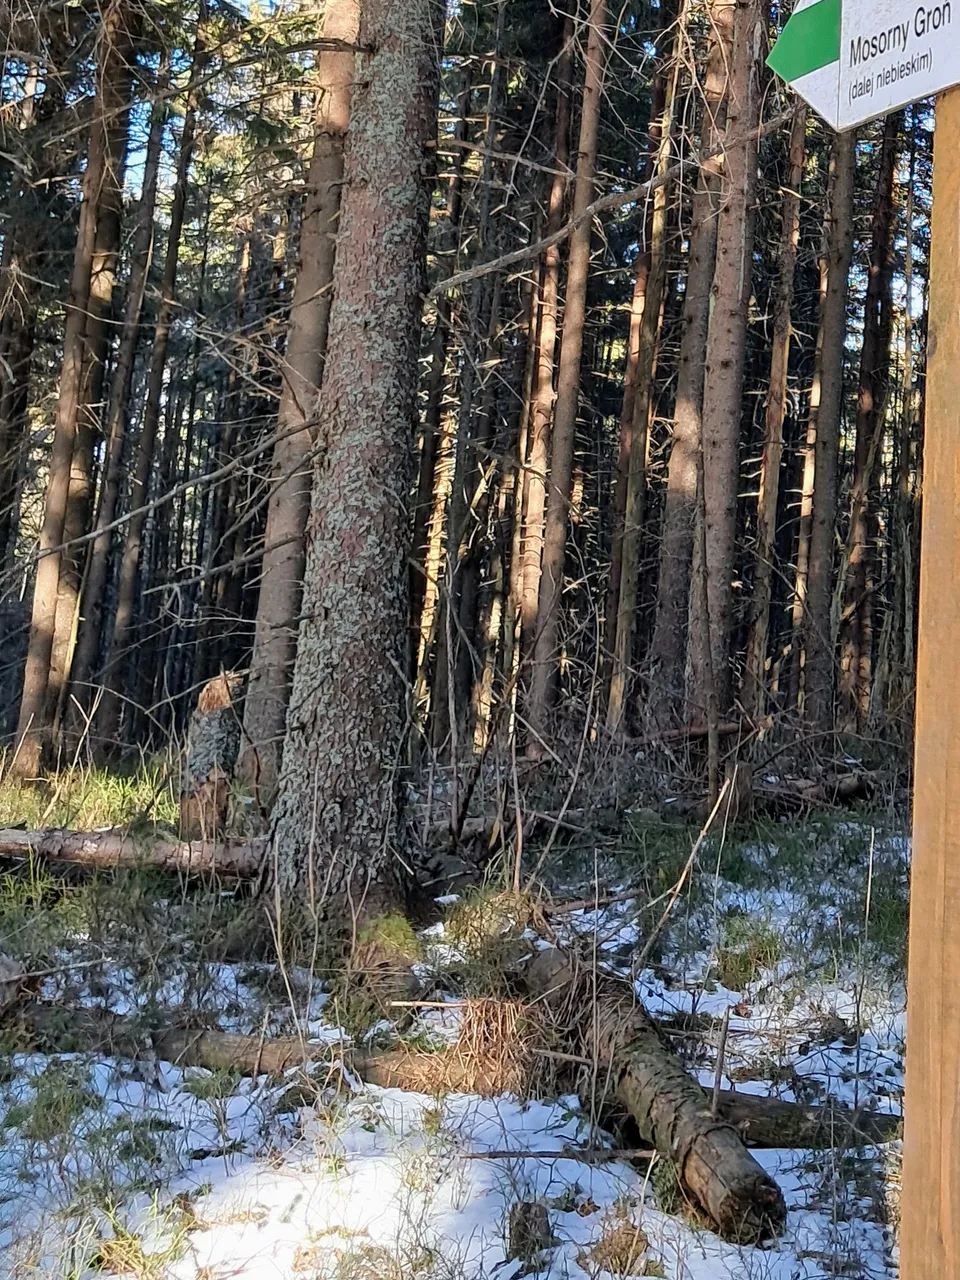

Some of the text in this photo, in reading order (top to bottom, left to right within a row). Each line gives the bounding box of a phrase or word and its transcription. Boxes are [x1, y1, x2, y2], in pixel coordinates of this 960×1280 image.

[849, 19, 909, 68] Mosorny
[848, 47, 933, 105] (dalej niebieskim)
